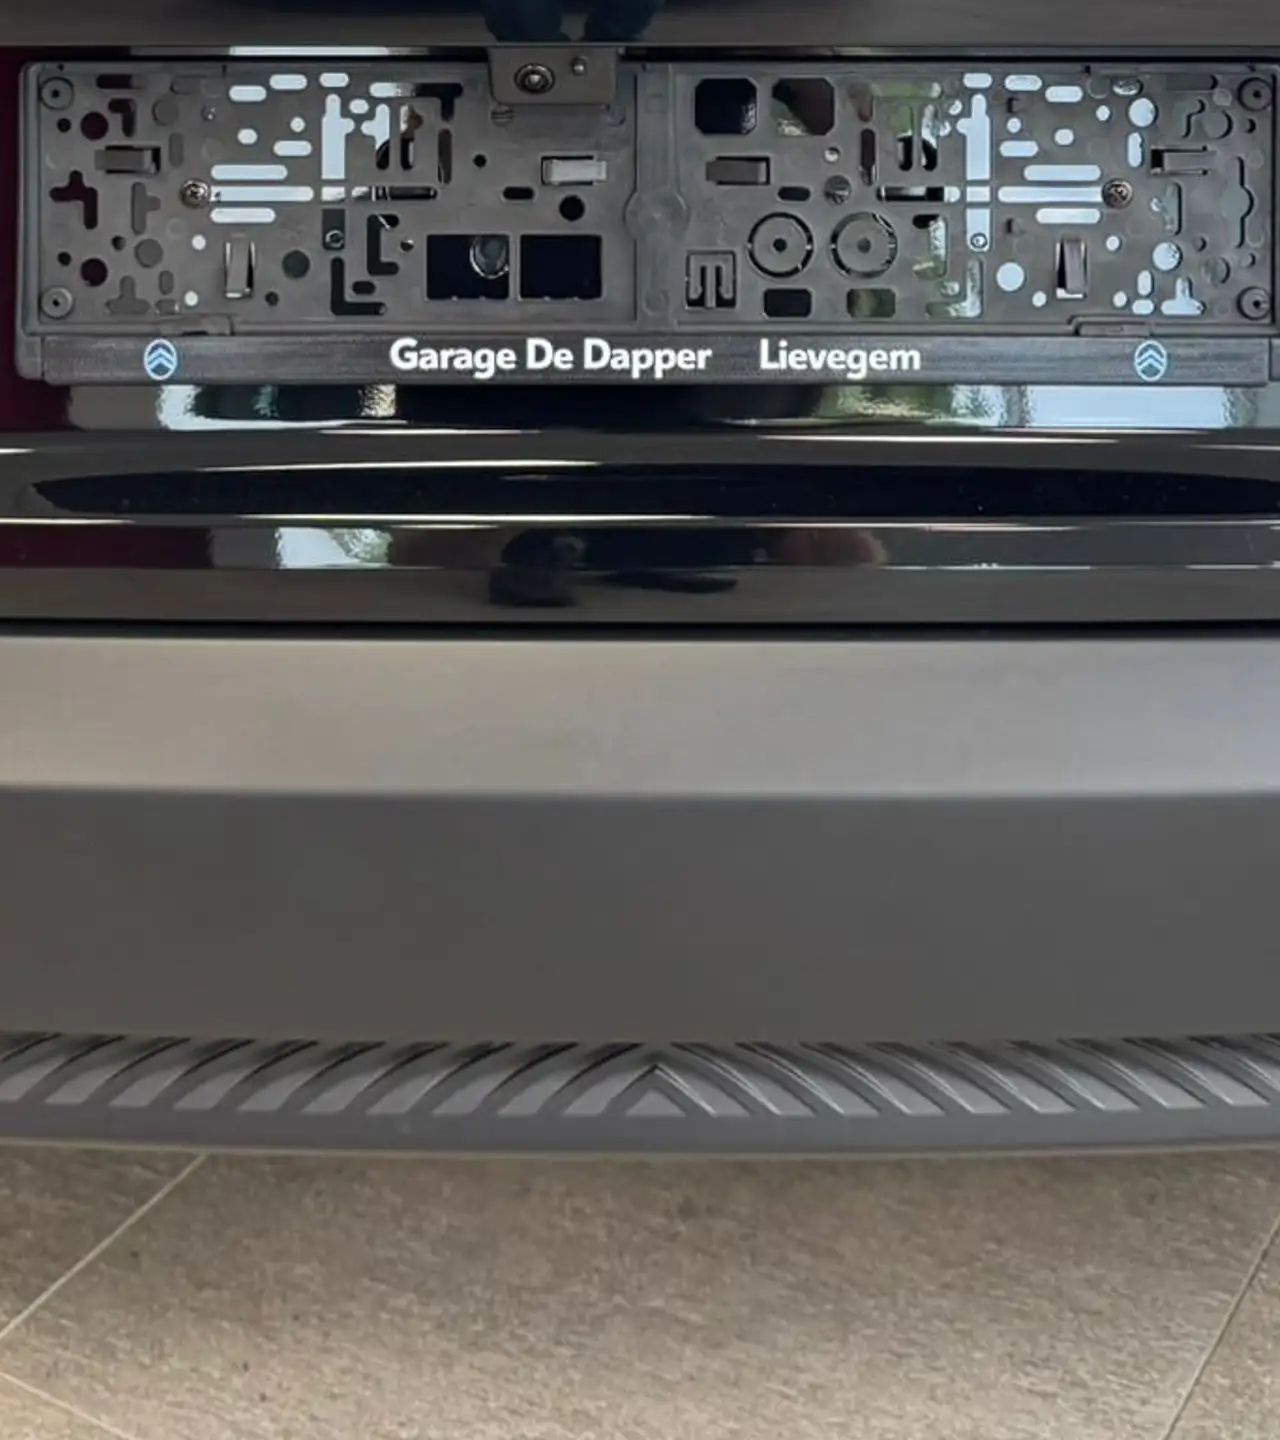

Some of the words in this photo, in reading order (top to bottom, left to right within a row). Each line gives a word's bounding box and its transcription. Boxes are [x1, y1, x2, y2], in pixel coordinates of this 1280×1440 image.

[389, 336, 517, 379] Garage
[526, 337, 574, 371] De
[583, 337, 713, 379] Dapper
[759, 337, 922, 379] Lievegem
